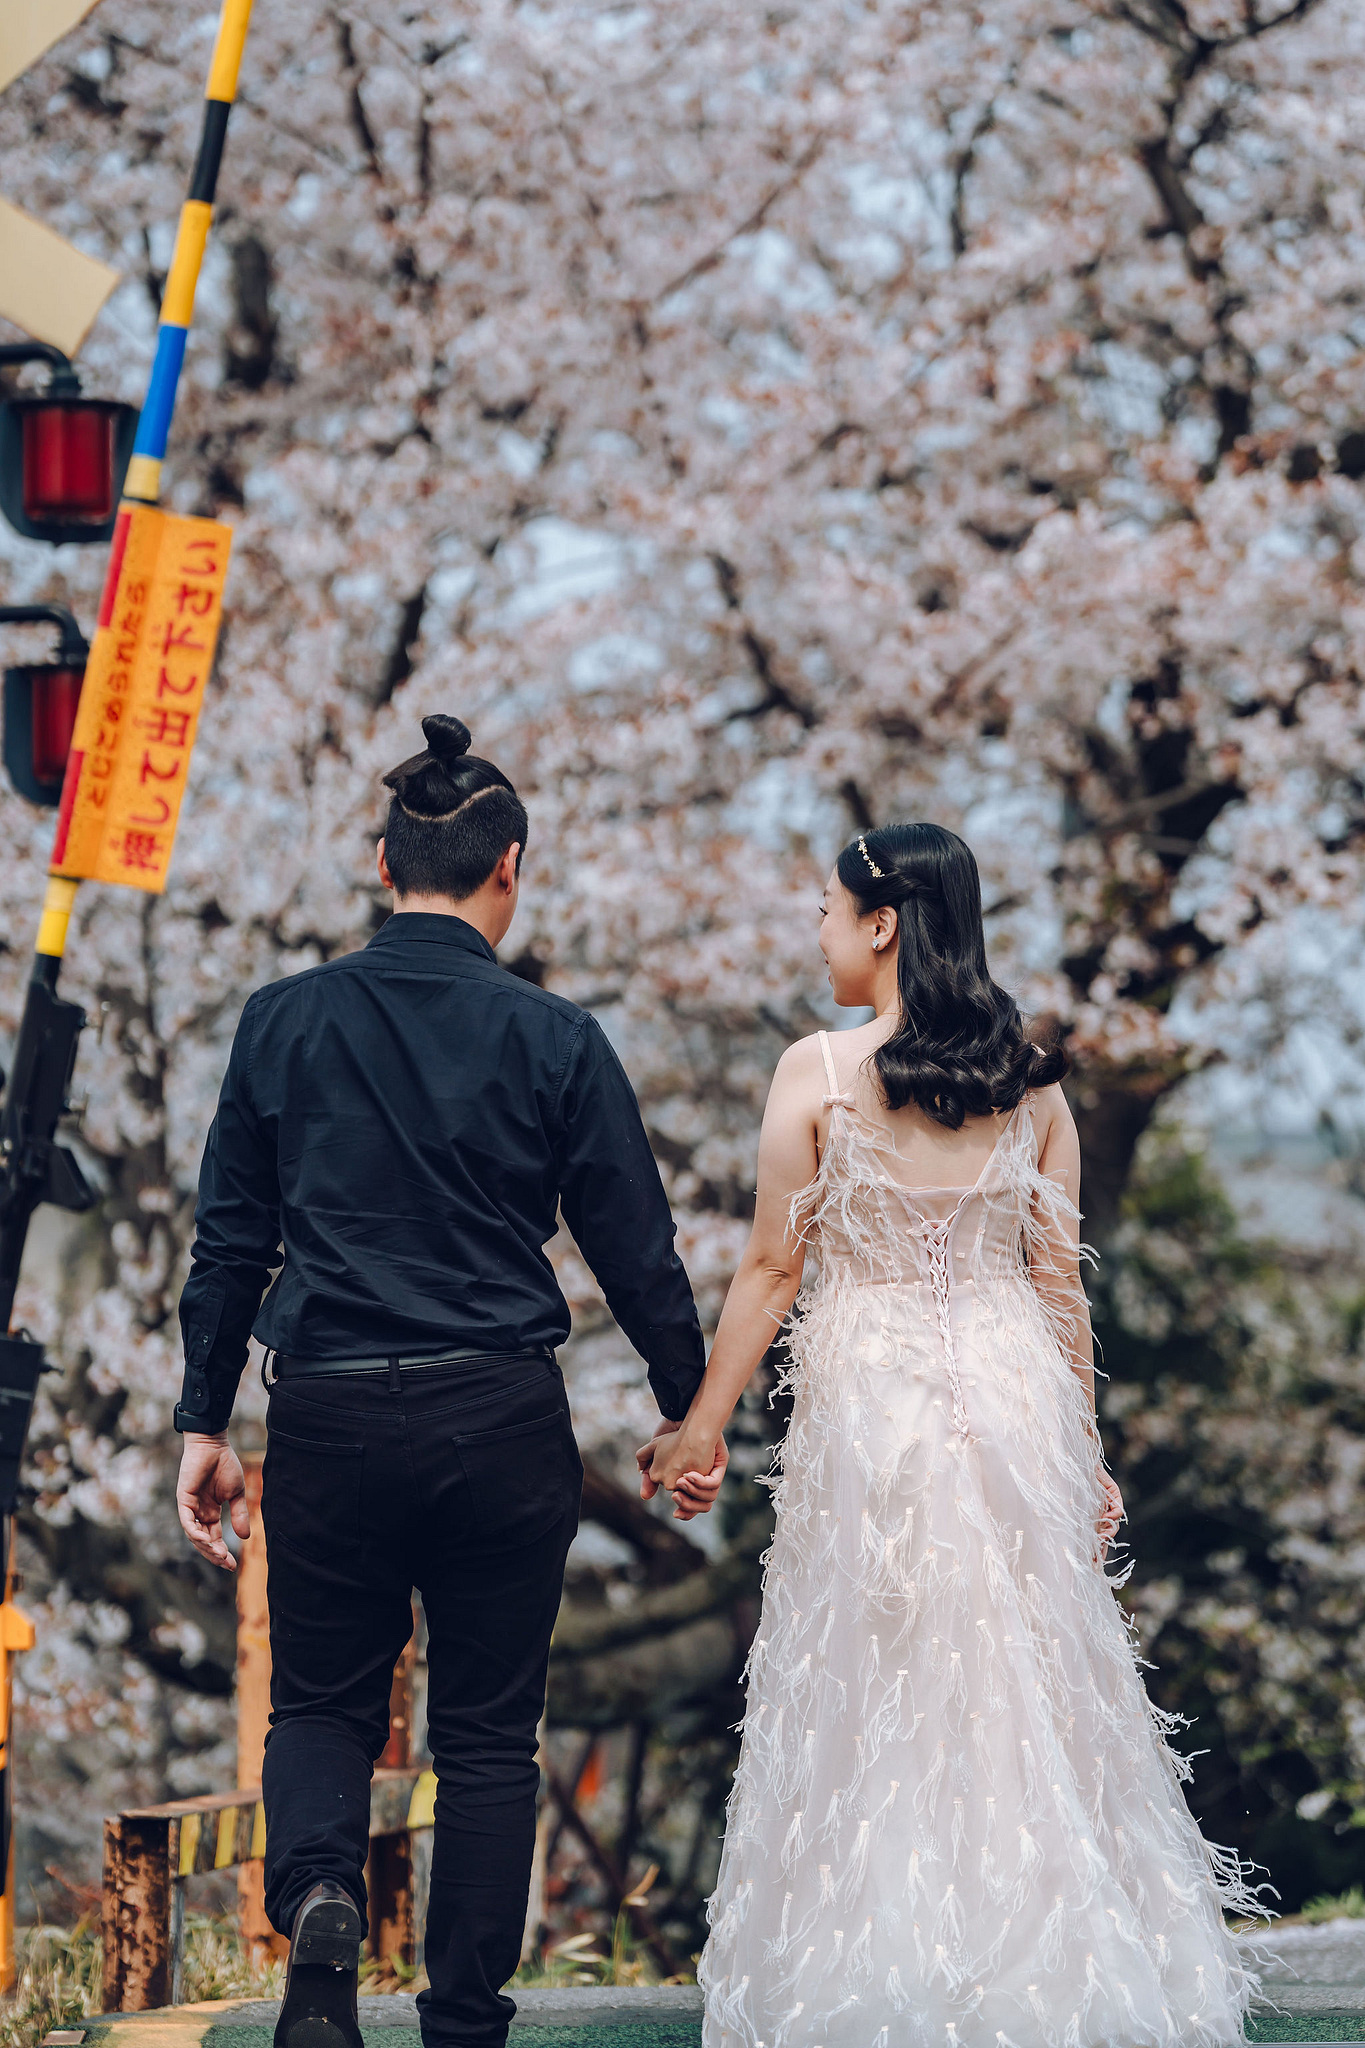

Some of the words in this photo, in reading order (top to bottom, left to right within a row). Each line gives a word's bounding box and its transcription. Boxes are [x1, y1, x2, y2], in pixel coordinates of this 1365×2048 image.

[86, 582, 147, 809] とじこめられたら
[119, 539, 217, 871] 押して出て下さい
